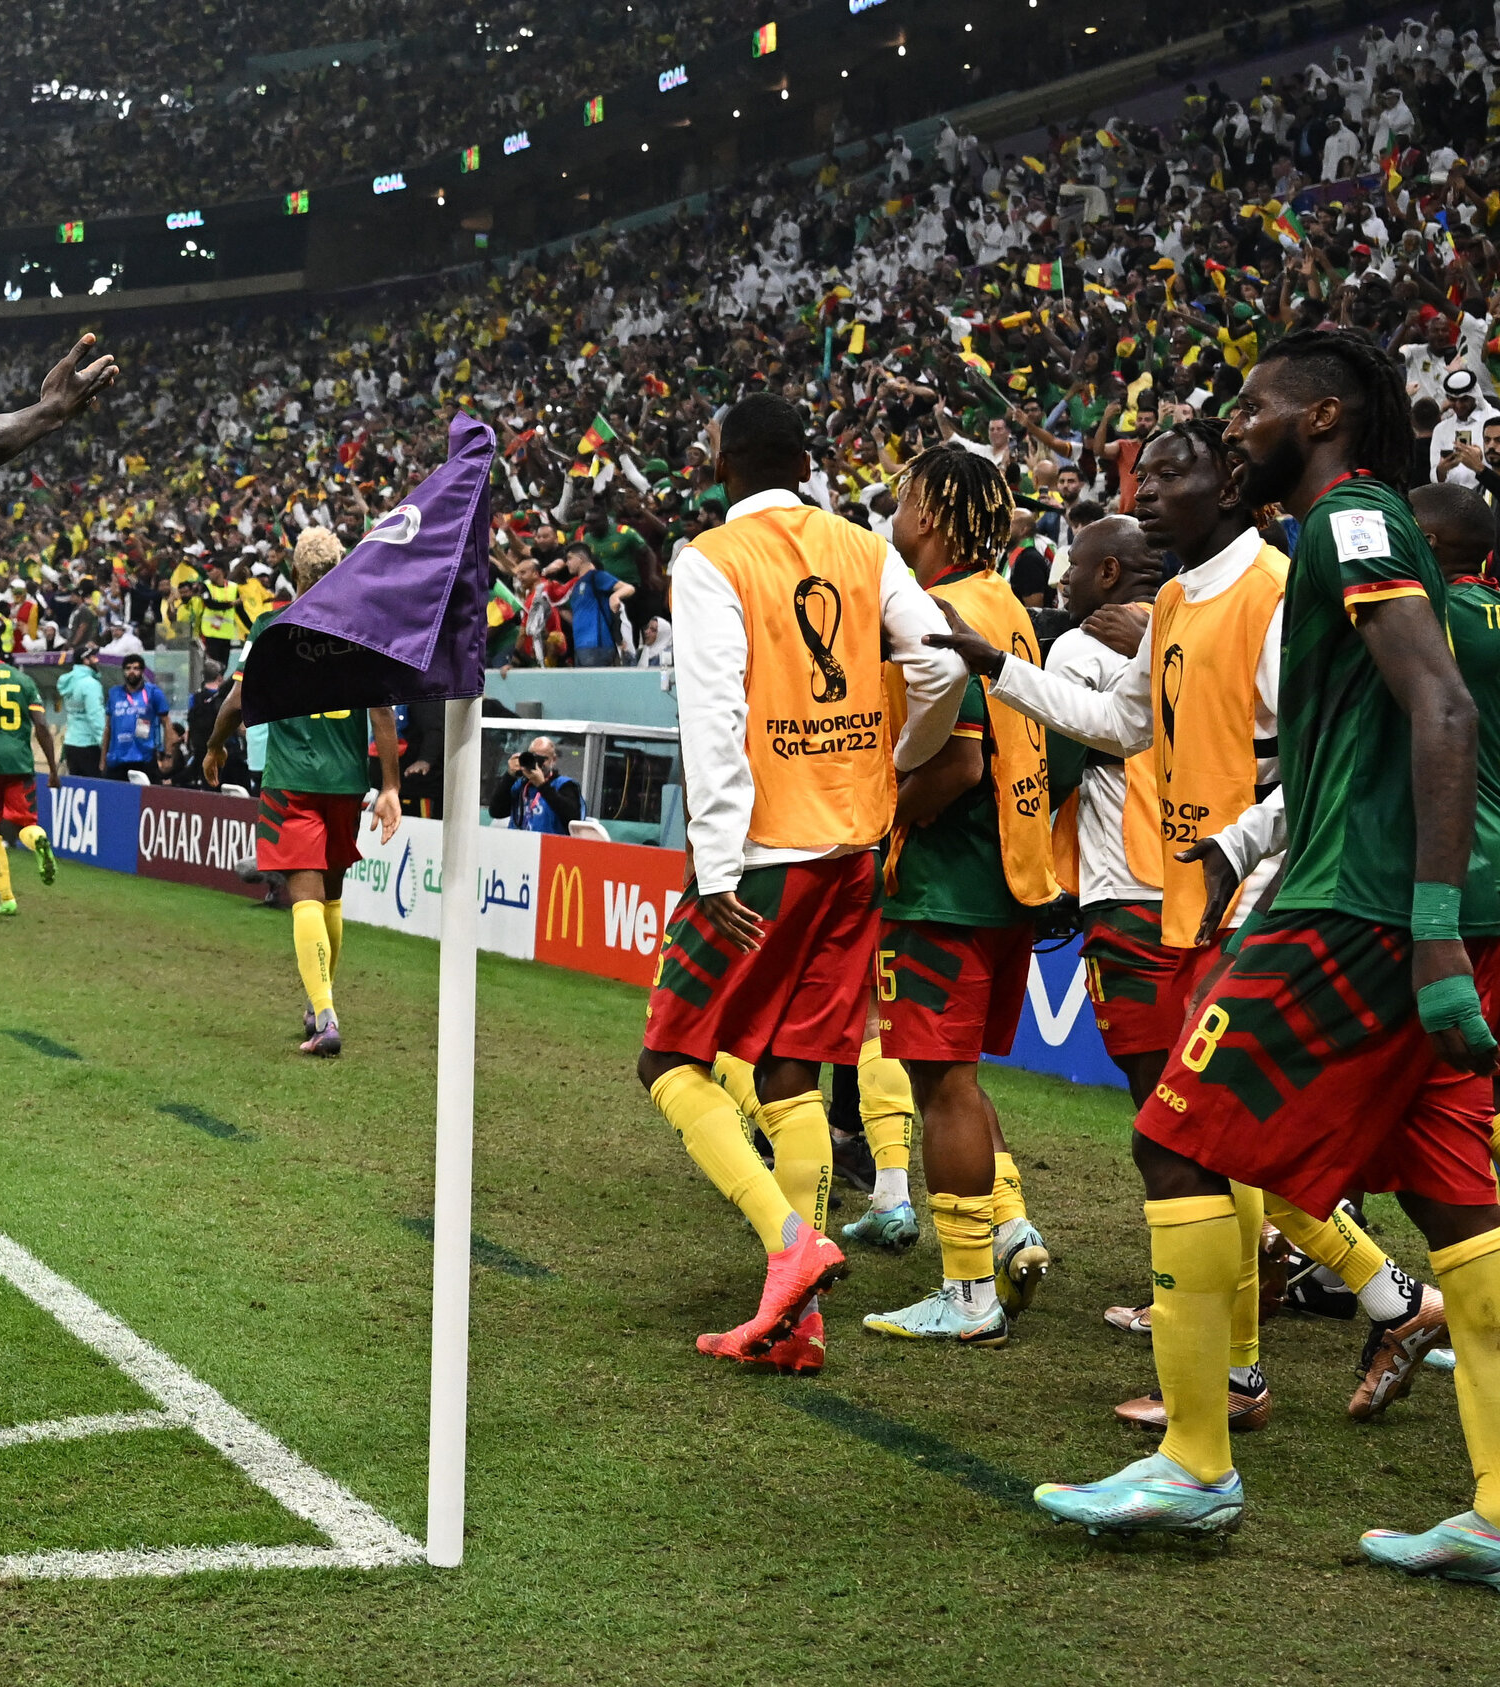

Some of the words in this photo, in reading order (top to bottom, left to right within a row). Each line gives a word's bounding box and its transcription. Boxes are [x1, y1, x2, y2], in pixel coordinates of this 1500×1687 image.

[658, 65, 688, 92] GOAL
[503, 131, 530, 155] GOAL
[373, 174, 406, 194] GOAL
[167, 210, 204, 230] GOAL
[766, 719, 800, 734] FIFA
[850, 711, 882, 729] CUP
[1010, 776, 1037, 798] IFA
[50, 787, 98, 856] VISA
[1178, 803, 1210, 822] CUP
[139, 807, 202, 866] QATAR
[205, 816, 257, 872] AIRW
[344, 858, 391, 892] nergy
[481, 869, 530, 914] قطر
[603, 880, 658, 956] We
[1181, 1003, 1230, 1073] 8
[1155, 1083, 1188, 1113] one
[813, 1165, 830, 1231] CAMEROU
